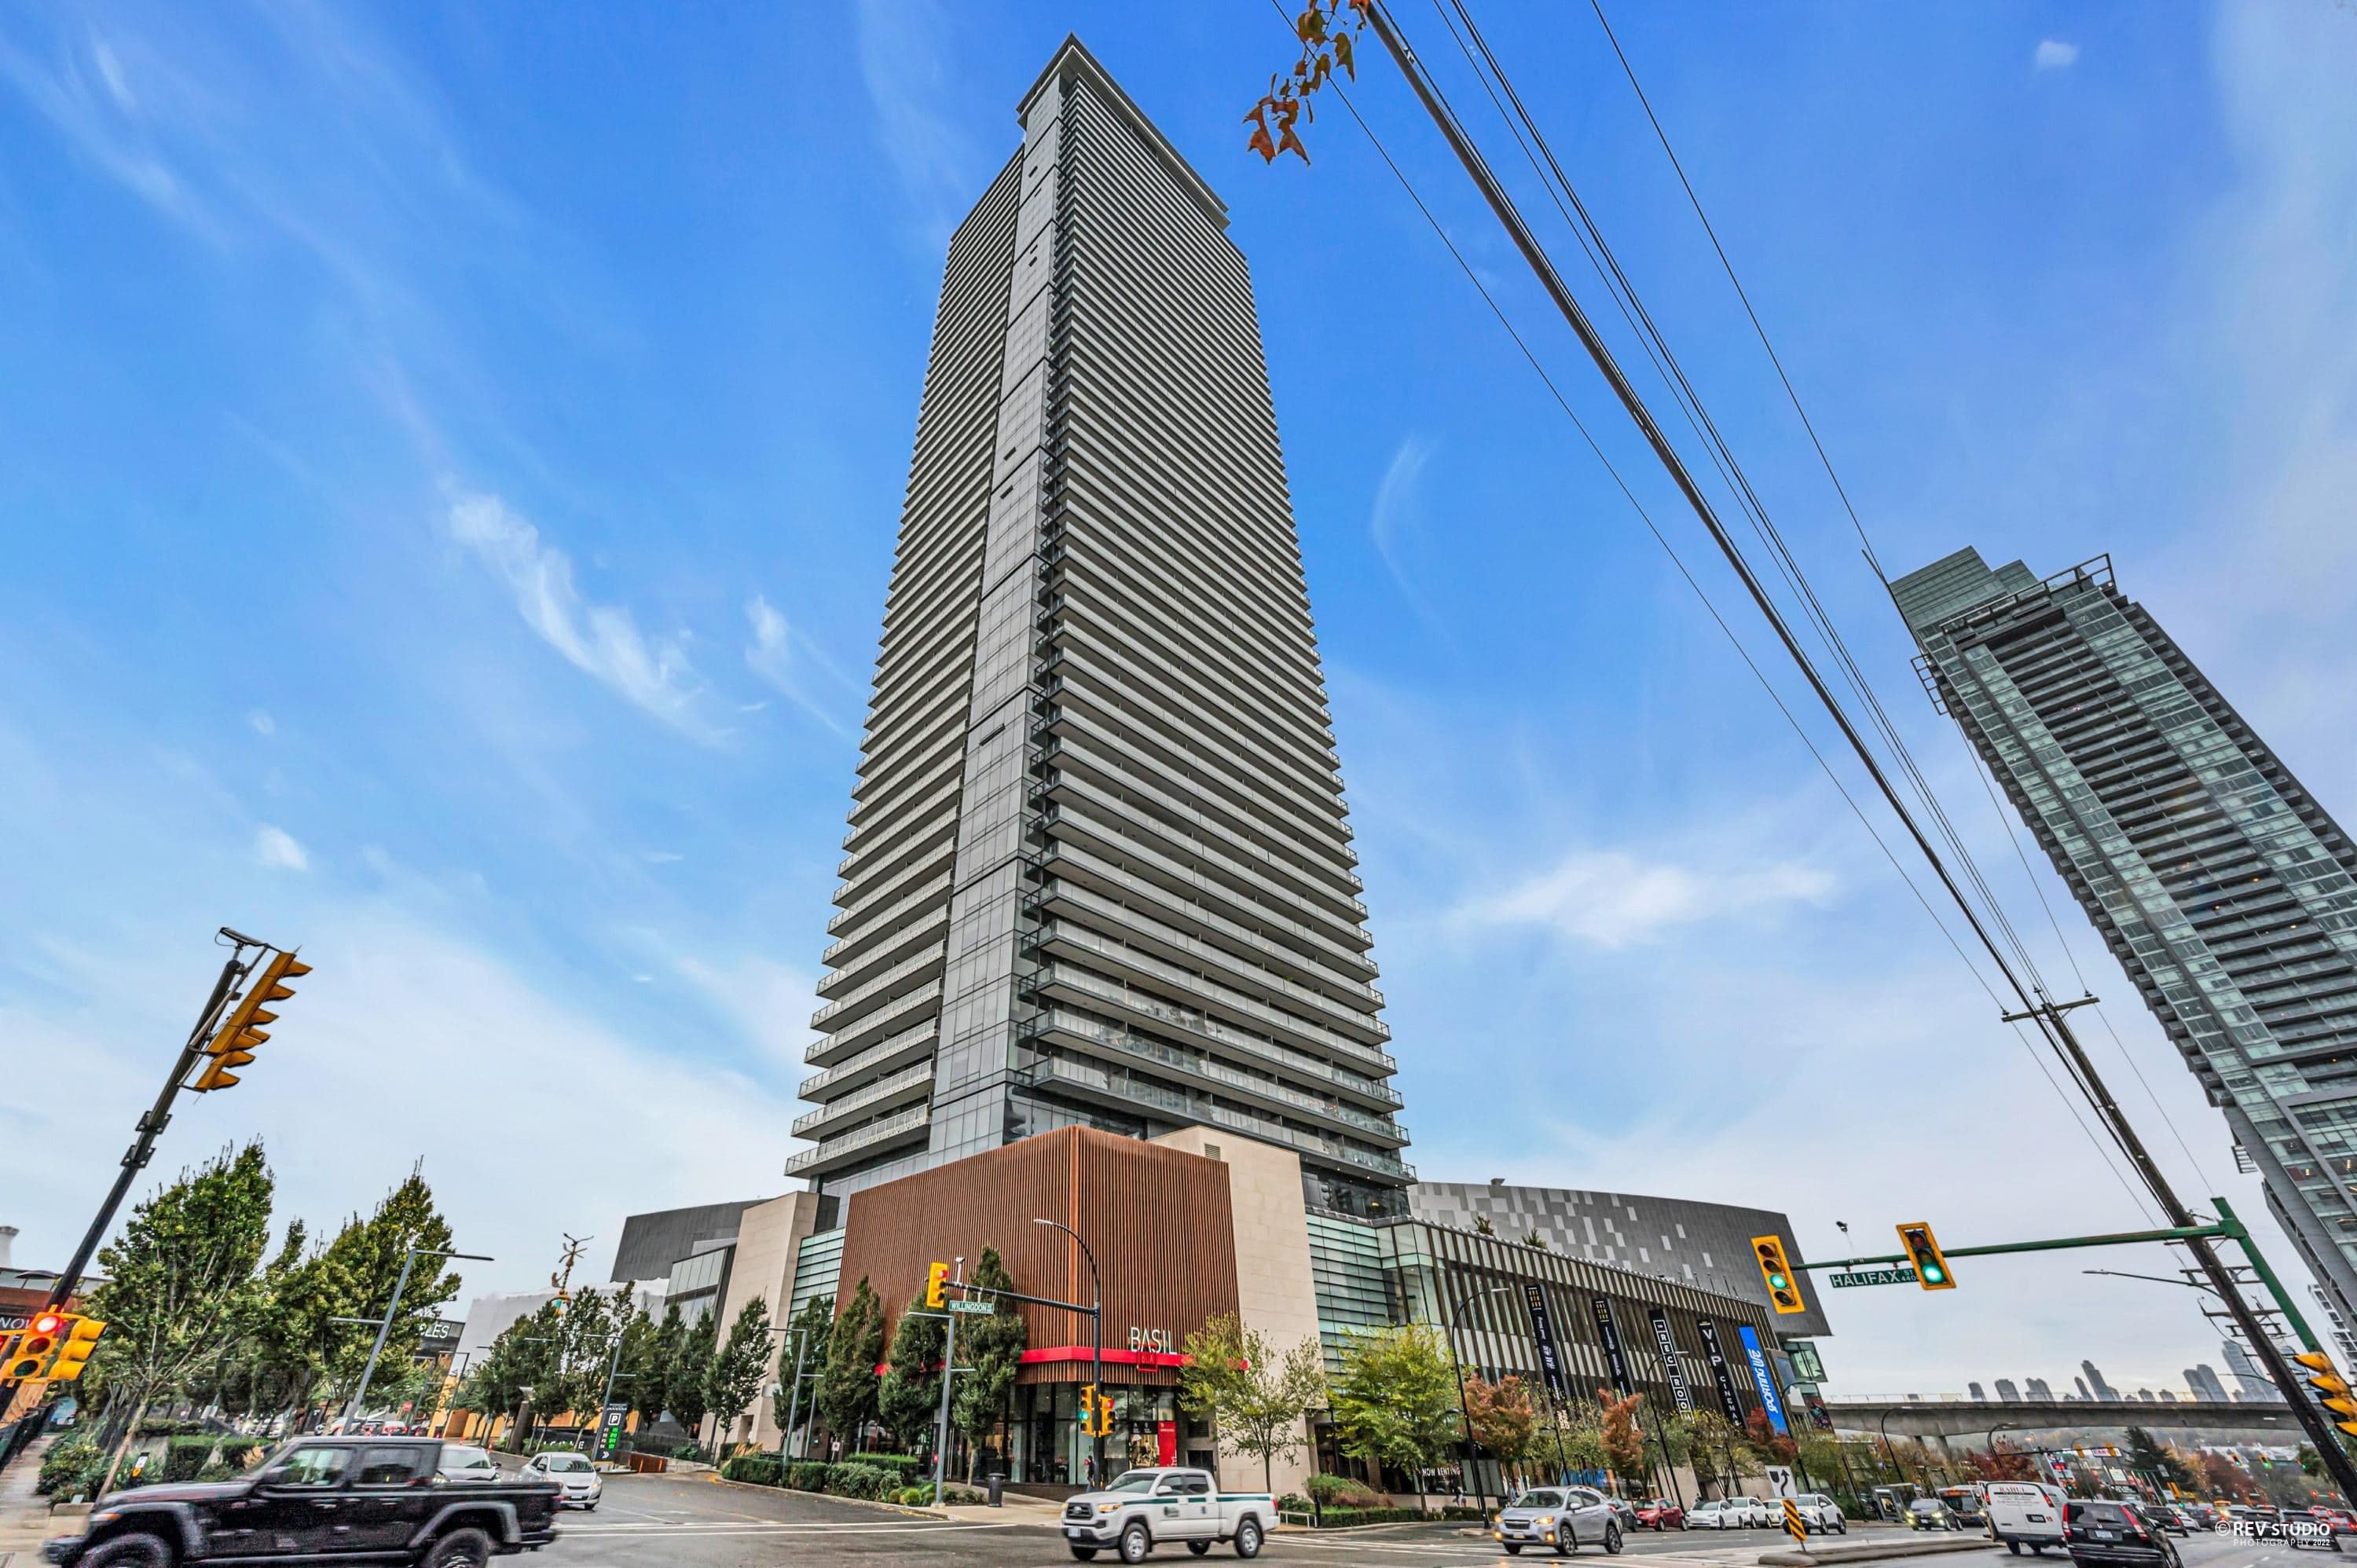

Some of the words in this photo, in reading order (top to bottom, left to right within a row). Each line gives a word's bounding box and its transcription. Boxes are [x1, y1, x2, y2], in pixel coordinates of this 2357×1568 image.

[1831, 1270, 1900, 1287] HALIFAX
[951, 1302, 987, 1312] WILLINGDON
[1131, 1326, 1178, 1355] BASIL
[1660, 1333, 1674, 1364] REC
[1702, 1328, 1723, 1367] VIP
[1720, 1376, 1741, 1427] CINEMAS
[1754, 1367, 1778, 1414] SPORTING
[1422, 1467, 1435, 1477] NOW
[1437, 1467, 1460, 1476] RENTING
